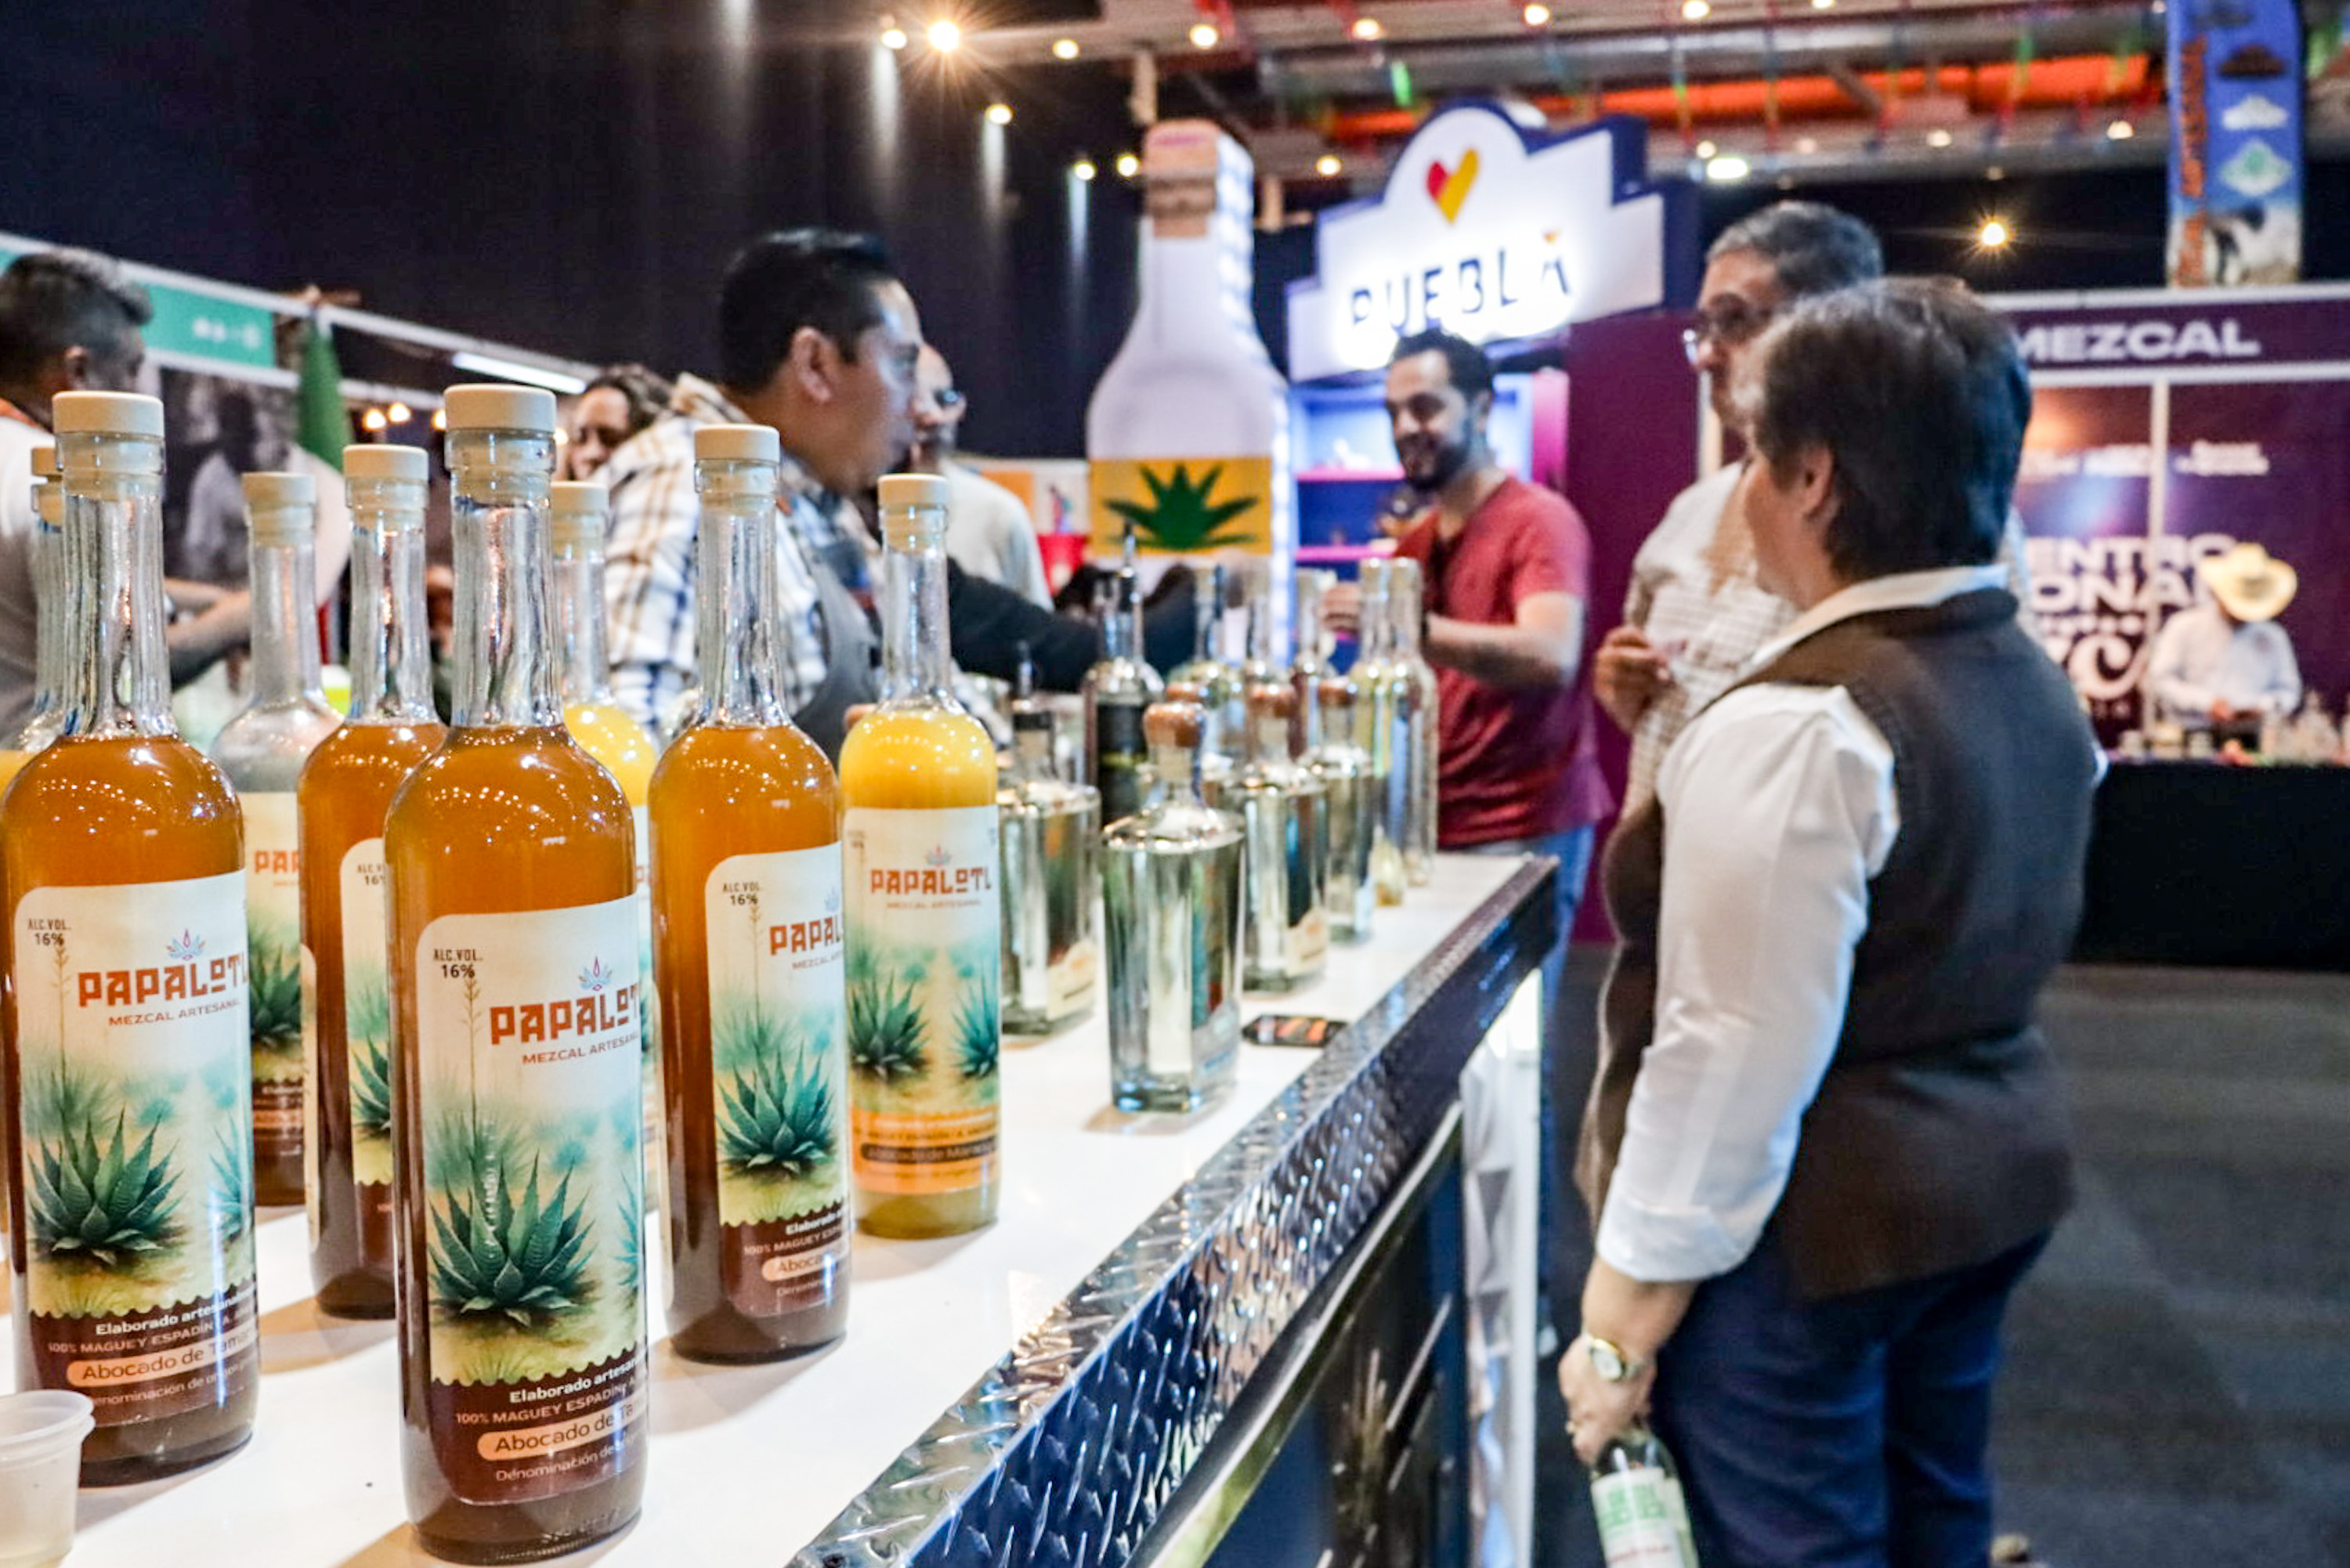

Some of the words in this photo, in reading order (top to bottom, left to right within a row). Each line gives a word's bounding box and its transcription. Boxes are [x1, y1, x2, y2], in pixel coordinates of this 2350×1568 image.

[870, 866, 992, 894] PAPALOTL
[730, 894, 758, 906] 16%
[35, 933, 65, 946] 16%
[441, 963, 475, 978] 16%
[109, 1011, 174, 1027] MEZCAL
[522, 1048, 584, 1064] MEZCAL
[774, 1233, 821, 1252] MAGUEY
[96, 1315, 178, 1335] Elaborado
[48, 1341, 77, 1353] 100%
[81, 1338, 147, 1353] MAGUEY
[82, 1359, 177, 1381] Abocado
[182, 1347, 204, 1365] de
[92, 1382, 186, 1406] enominación
[187, 1374, 208, 1389] de
[509, 1376, 591, 1404] Elaborado
[455, 1411, 490, 1425] 100%
[493, 1403, 562, 1425] MAGUEY
[494, 1423, 591, 1453] Abocado
[594, 1412, 614, 1433] de
[496, 1450, 599, 1482] Denominación
